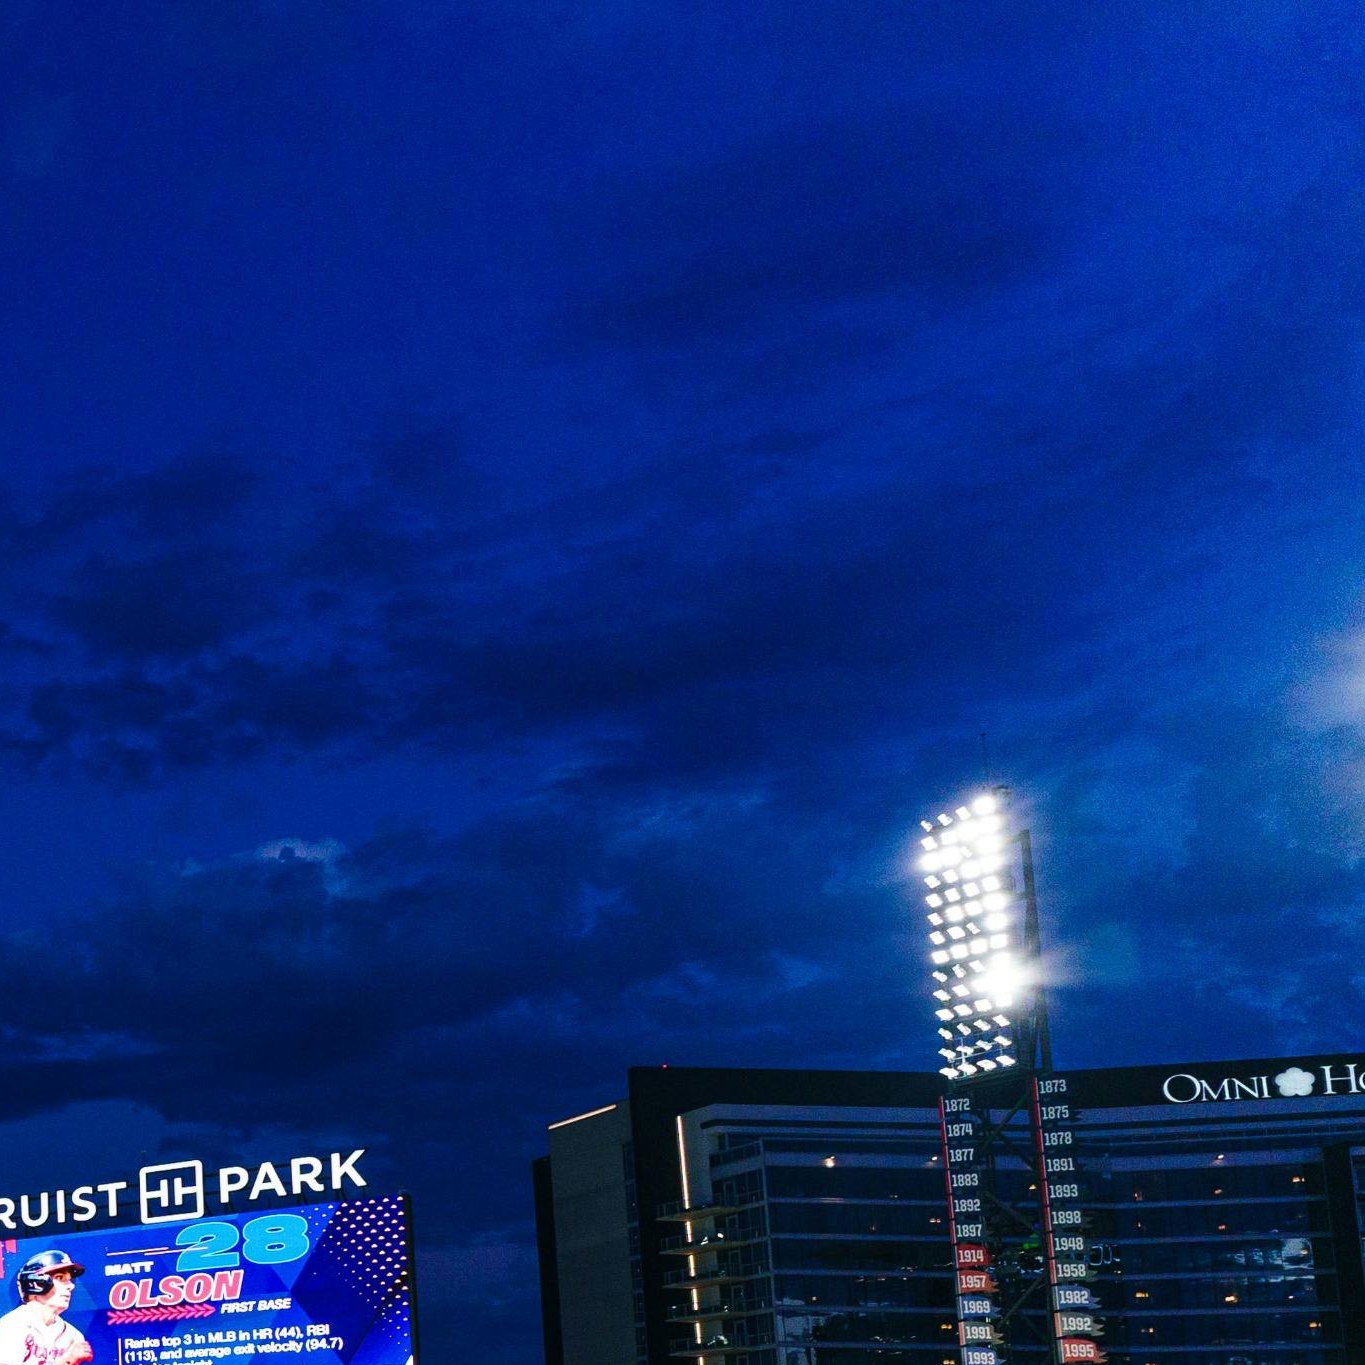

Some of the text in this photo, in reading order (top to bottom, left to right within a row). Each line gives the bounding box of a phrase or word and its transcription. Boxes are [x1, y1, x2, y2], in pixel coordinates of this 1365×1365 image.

[1039, 1079, 1067, 1093] 1873
[945, 1098, 970, 1112] 1872
[1042, 1106, 1070, 1120] 1875
[947, 1123, 973, 1137] 1874
[1044, 1131, 1072, 1145] 1878
[949, 1149, 974, 1162] 1877
[1047, 1157, 1075, 1172] 1891
[219, 1149, 367, 1204] PARK
[952, 1174, 979, 1187] 1883
[1049, 1184, 1078, 1198] 1893
[954, 1199, 980, 1213] 1892
[1052, 1210, 1082, 1225] 1898
[956, 1224, 982, 1237] 1897
[176, 1214, 310, 1272] 28
[1054, 1236, 1084, 1250] 1948
[959, 1249, 984, 1263] 1914
[105, 1261, 154, 1276] MATT
[1057, 1262, 1086, 1277] 1958
[960, 1274, 986, 1288] 1957
[109, 1270, 244, 1310] OLSON
[1059, 1290, 1089, 1304] 1982
[220, 1298, 292, 1314] FIRST BASE
[963, 1300, 991, 1314] 1969
[1061, 1316, 1092, 1331] 1992
[124, 1324, 331, 1350] Ranks top 3 in MLB in HR (44), RBI
[965, 1326, 992, 1339] 1991
[124, 1337, 344, 1363] (113), and average exit velocity (94.7)
[1064, 1343, 1095, 1358] 1995
[968, 1351, 995, 1365] 1993
